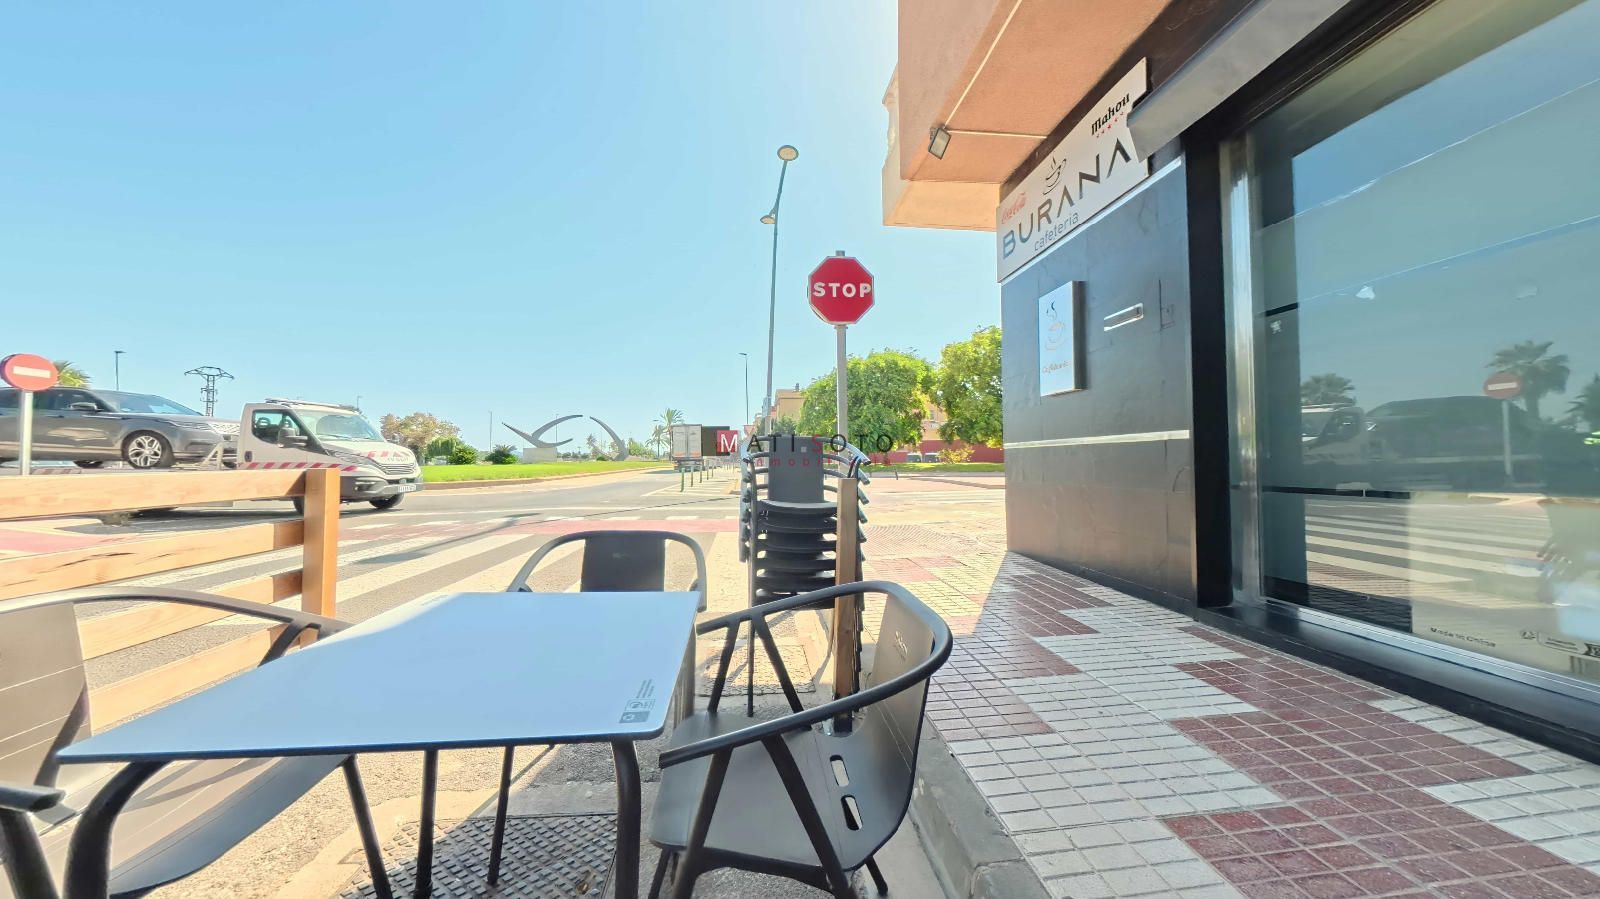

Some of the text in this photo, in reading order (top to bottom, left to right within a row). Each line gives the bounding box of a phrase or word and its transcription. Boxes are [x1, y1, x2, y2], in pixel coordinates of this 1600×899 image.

[1091, 93, 1130, 136] Mahou
[1002, 138, 1132, 260] BURANA
[813, 282, 872, 298] STOP
